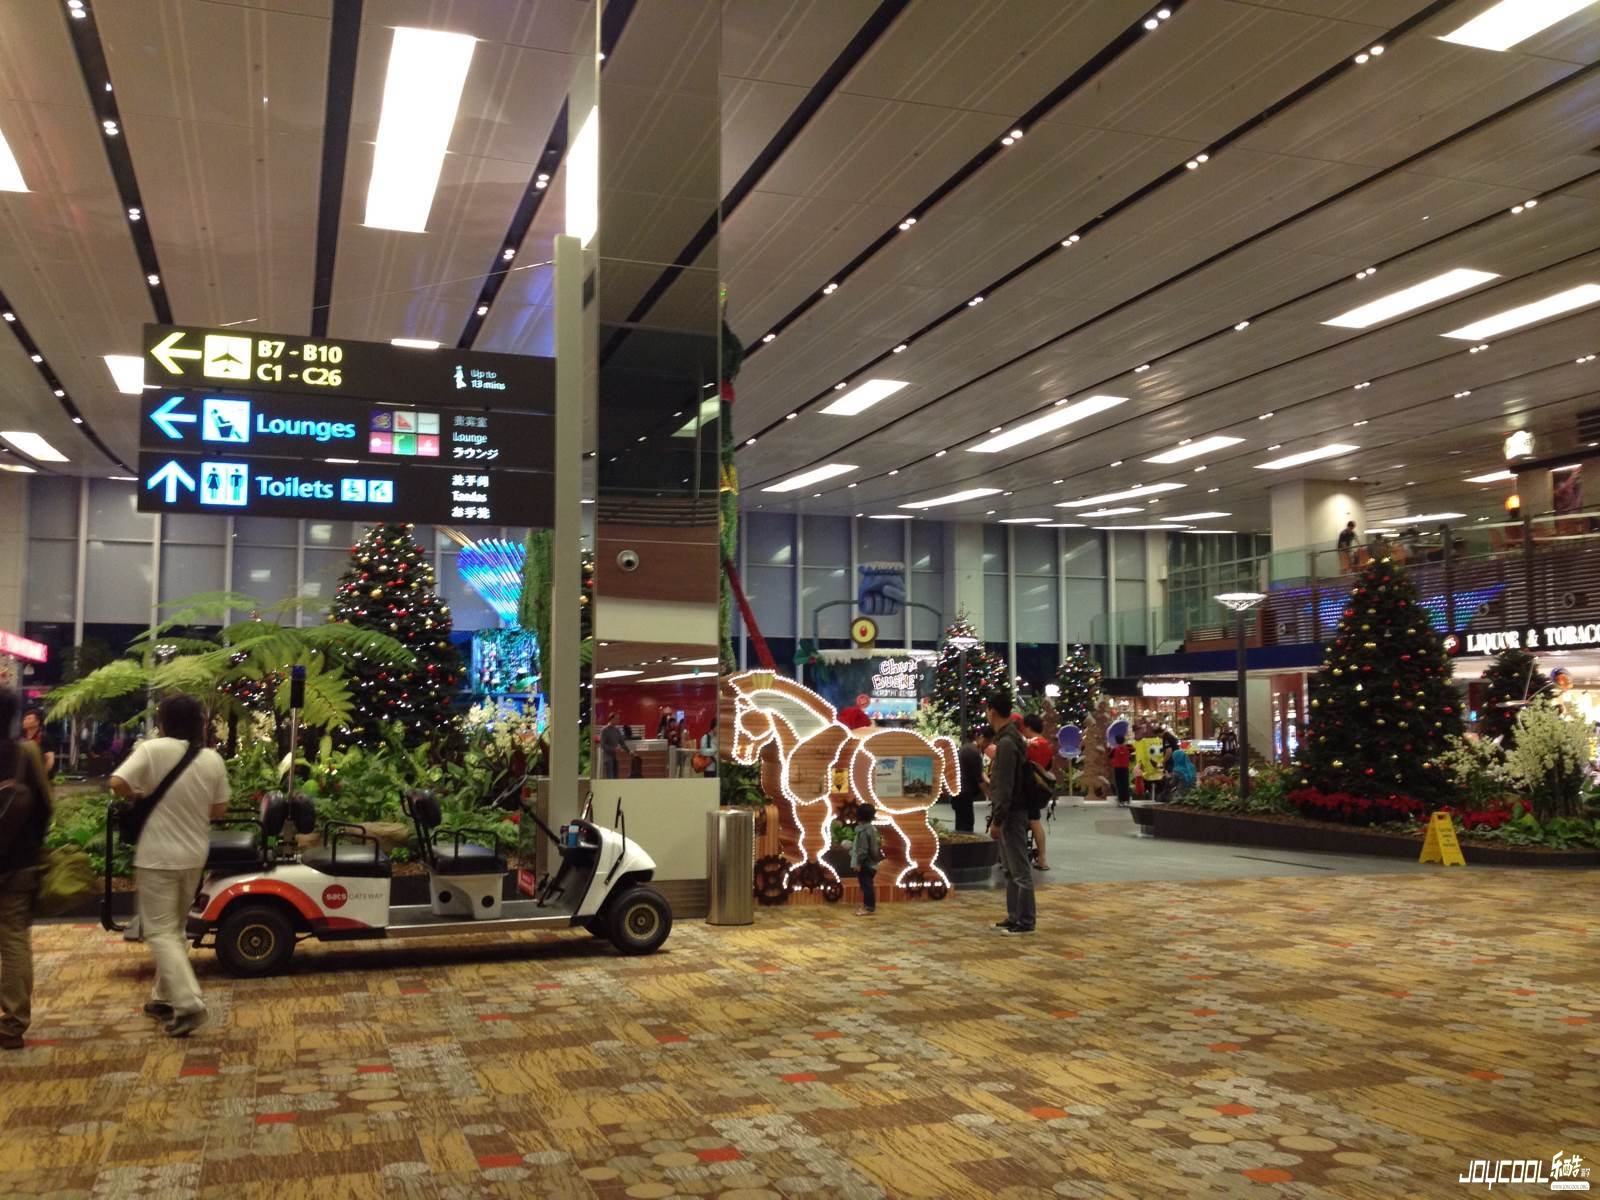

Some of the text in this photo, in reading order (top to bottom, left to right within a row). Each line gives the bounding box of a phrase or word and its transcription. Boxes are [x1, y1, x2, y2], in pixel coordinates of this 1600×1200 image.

[258, 340, 286, 358] B7
[303, 344, 343, 364] B10
[256, 363, 282, 381] C1
[302, 367, 342, 386] C26
[470, 369, 497, 379] Up to
[483, 381, 506, 390] mins
[256, 413, 356, 441] Lounges
[452, 431, 488, 445] Lounge
[452, 446, 499, 460] ラウンジ
[255, 476, 334, 499] Toilets
[1466, 631, 1520, 655] LIQUOR
[1526, 628, 1540, 648] &
